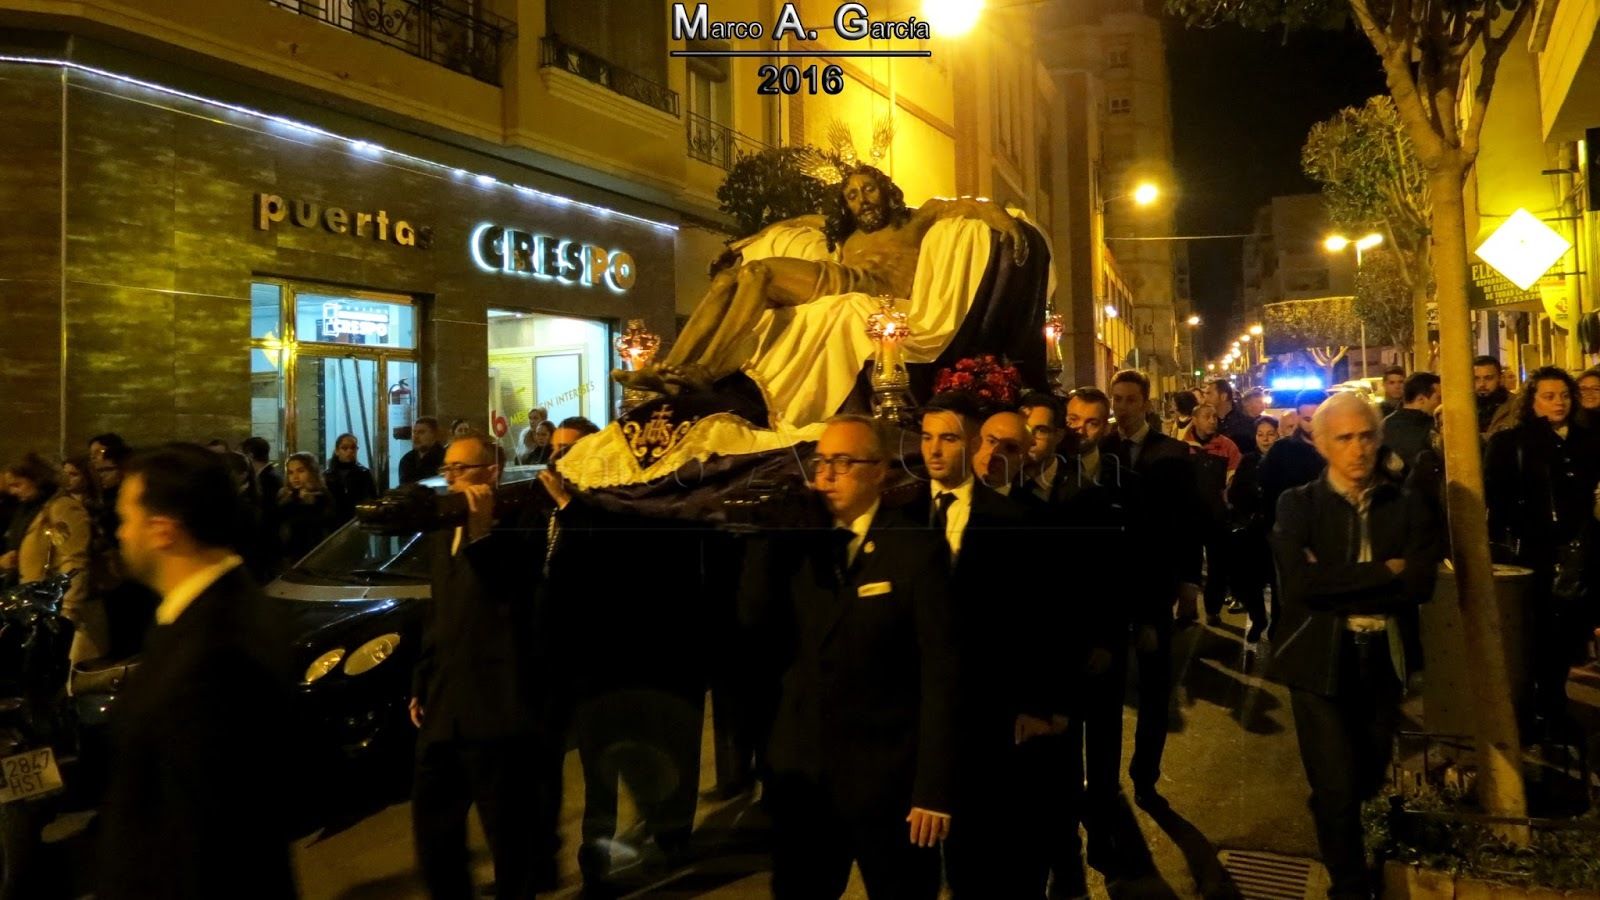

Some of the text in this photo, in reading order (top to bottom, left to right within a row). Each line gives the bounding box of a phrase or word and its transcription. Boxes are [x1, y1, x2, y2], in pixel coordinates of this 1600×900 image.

[255, 192, 434, 249] puertas
[471, 222, 637, 294] CRESPO
[6, 750, 50, 777] 2847
[10, 770, 44, 796] HST
